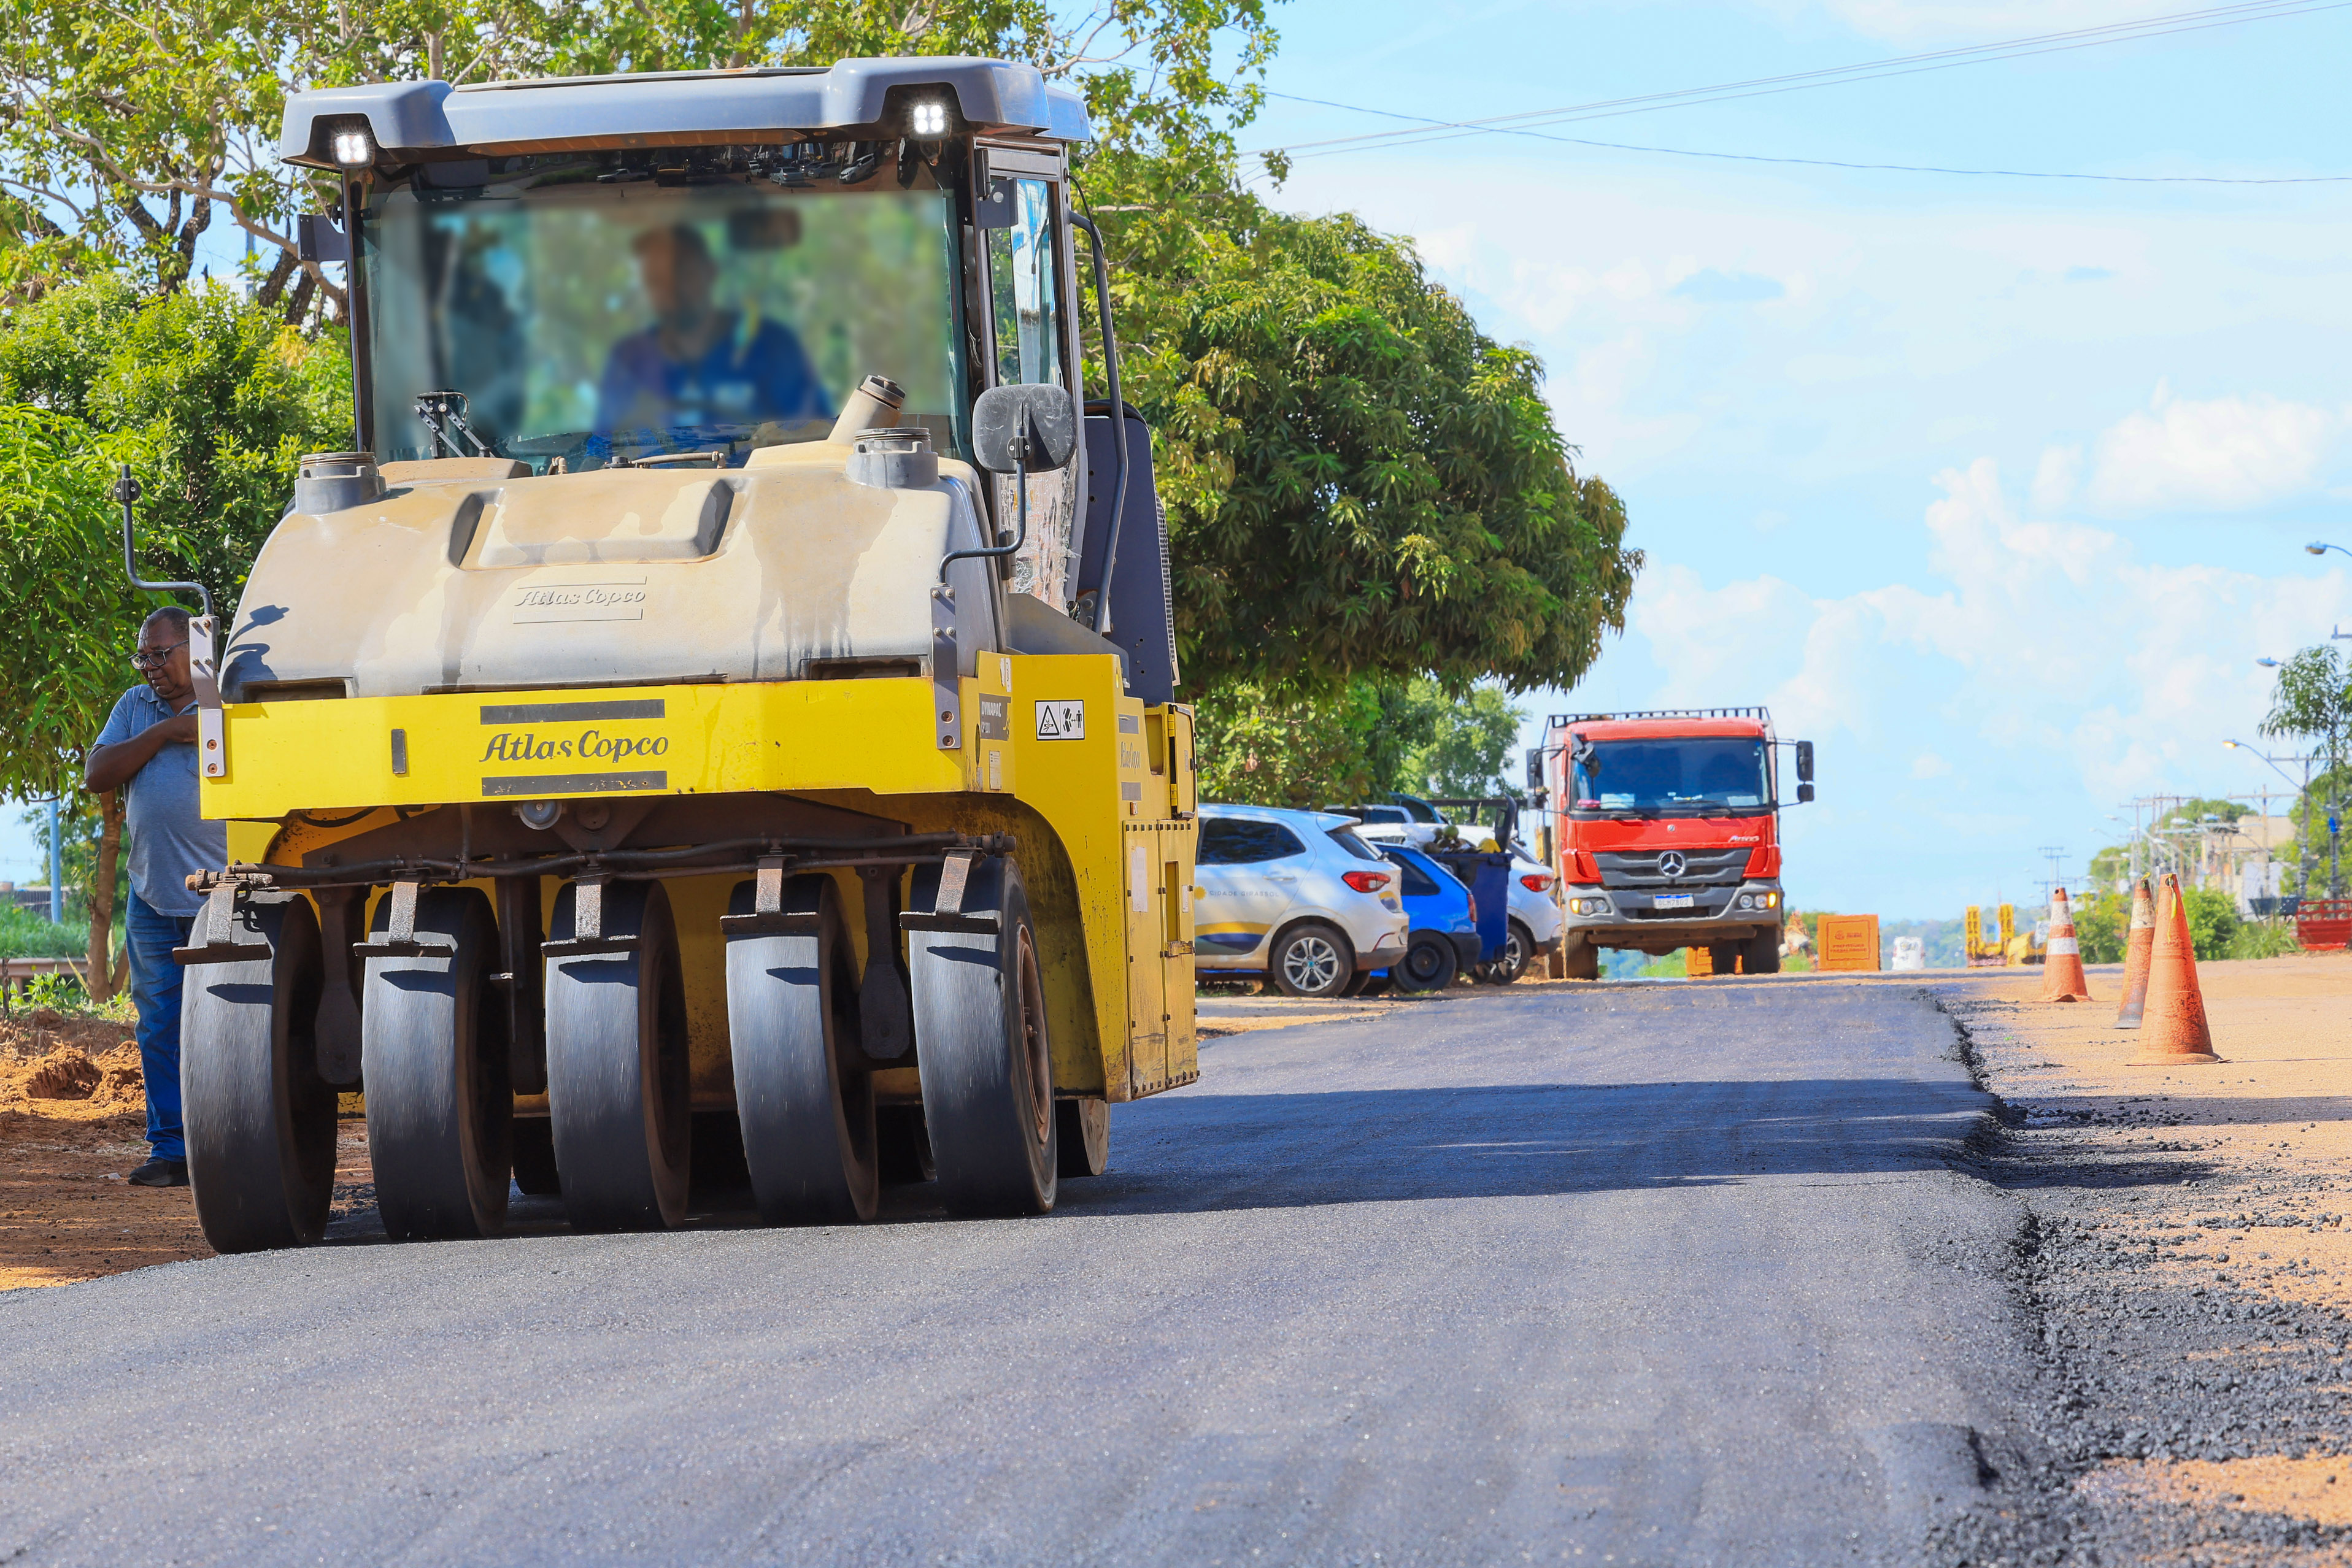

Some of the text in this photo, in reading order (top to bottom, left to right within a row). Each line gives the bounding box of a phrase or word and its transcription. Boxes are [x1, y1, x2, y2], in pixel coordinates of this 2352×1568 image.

[514, 589, 646, 606] Atlas Copco
[981, 701, 1001, 717] DYNAPAC
[479, 730, 668, 763] Atlas Copco
